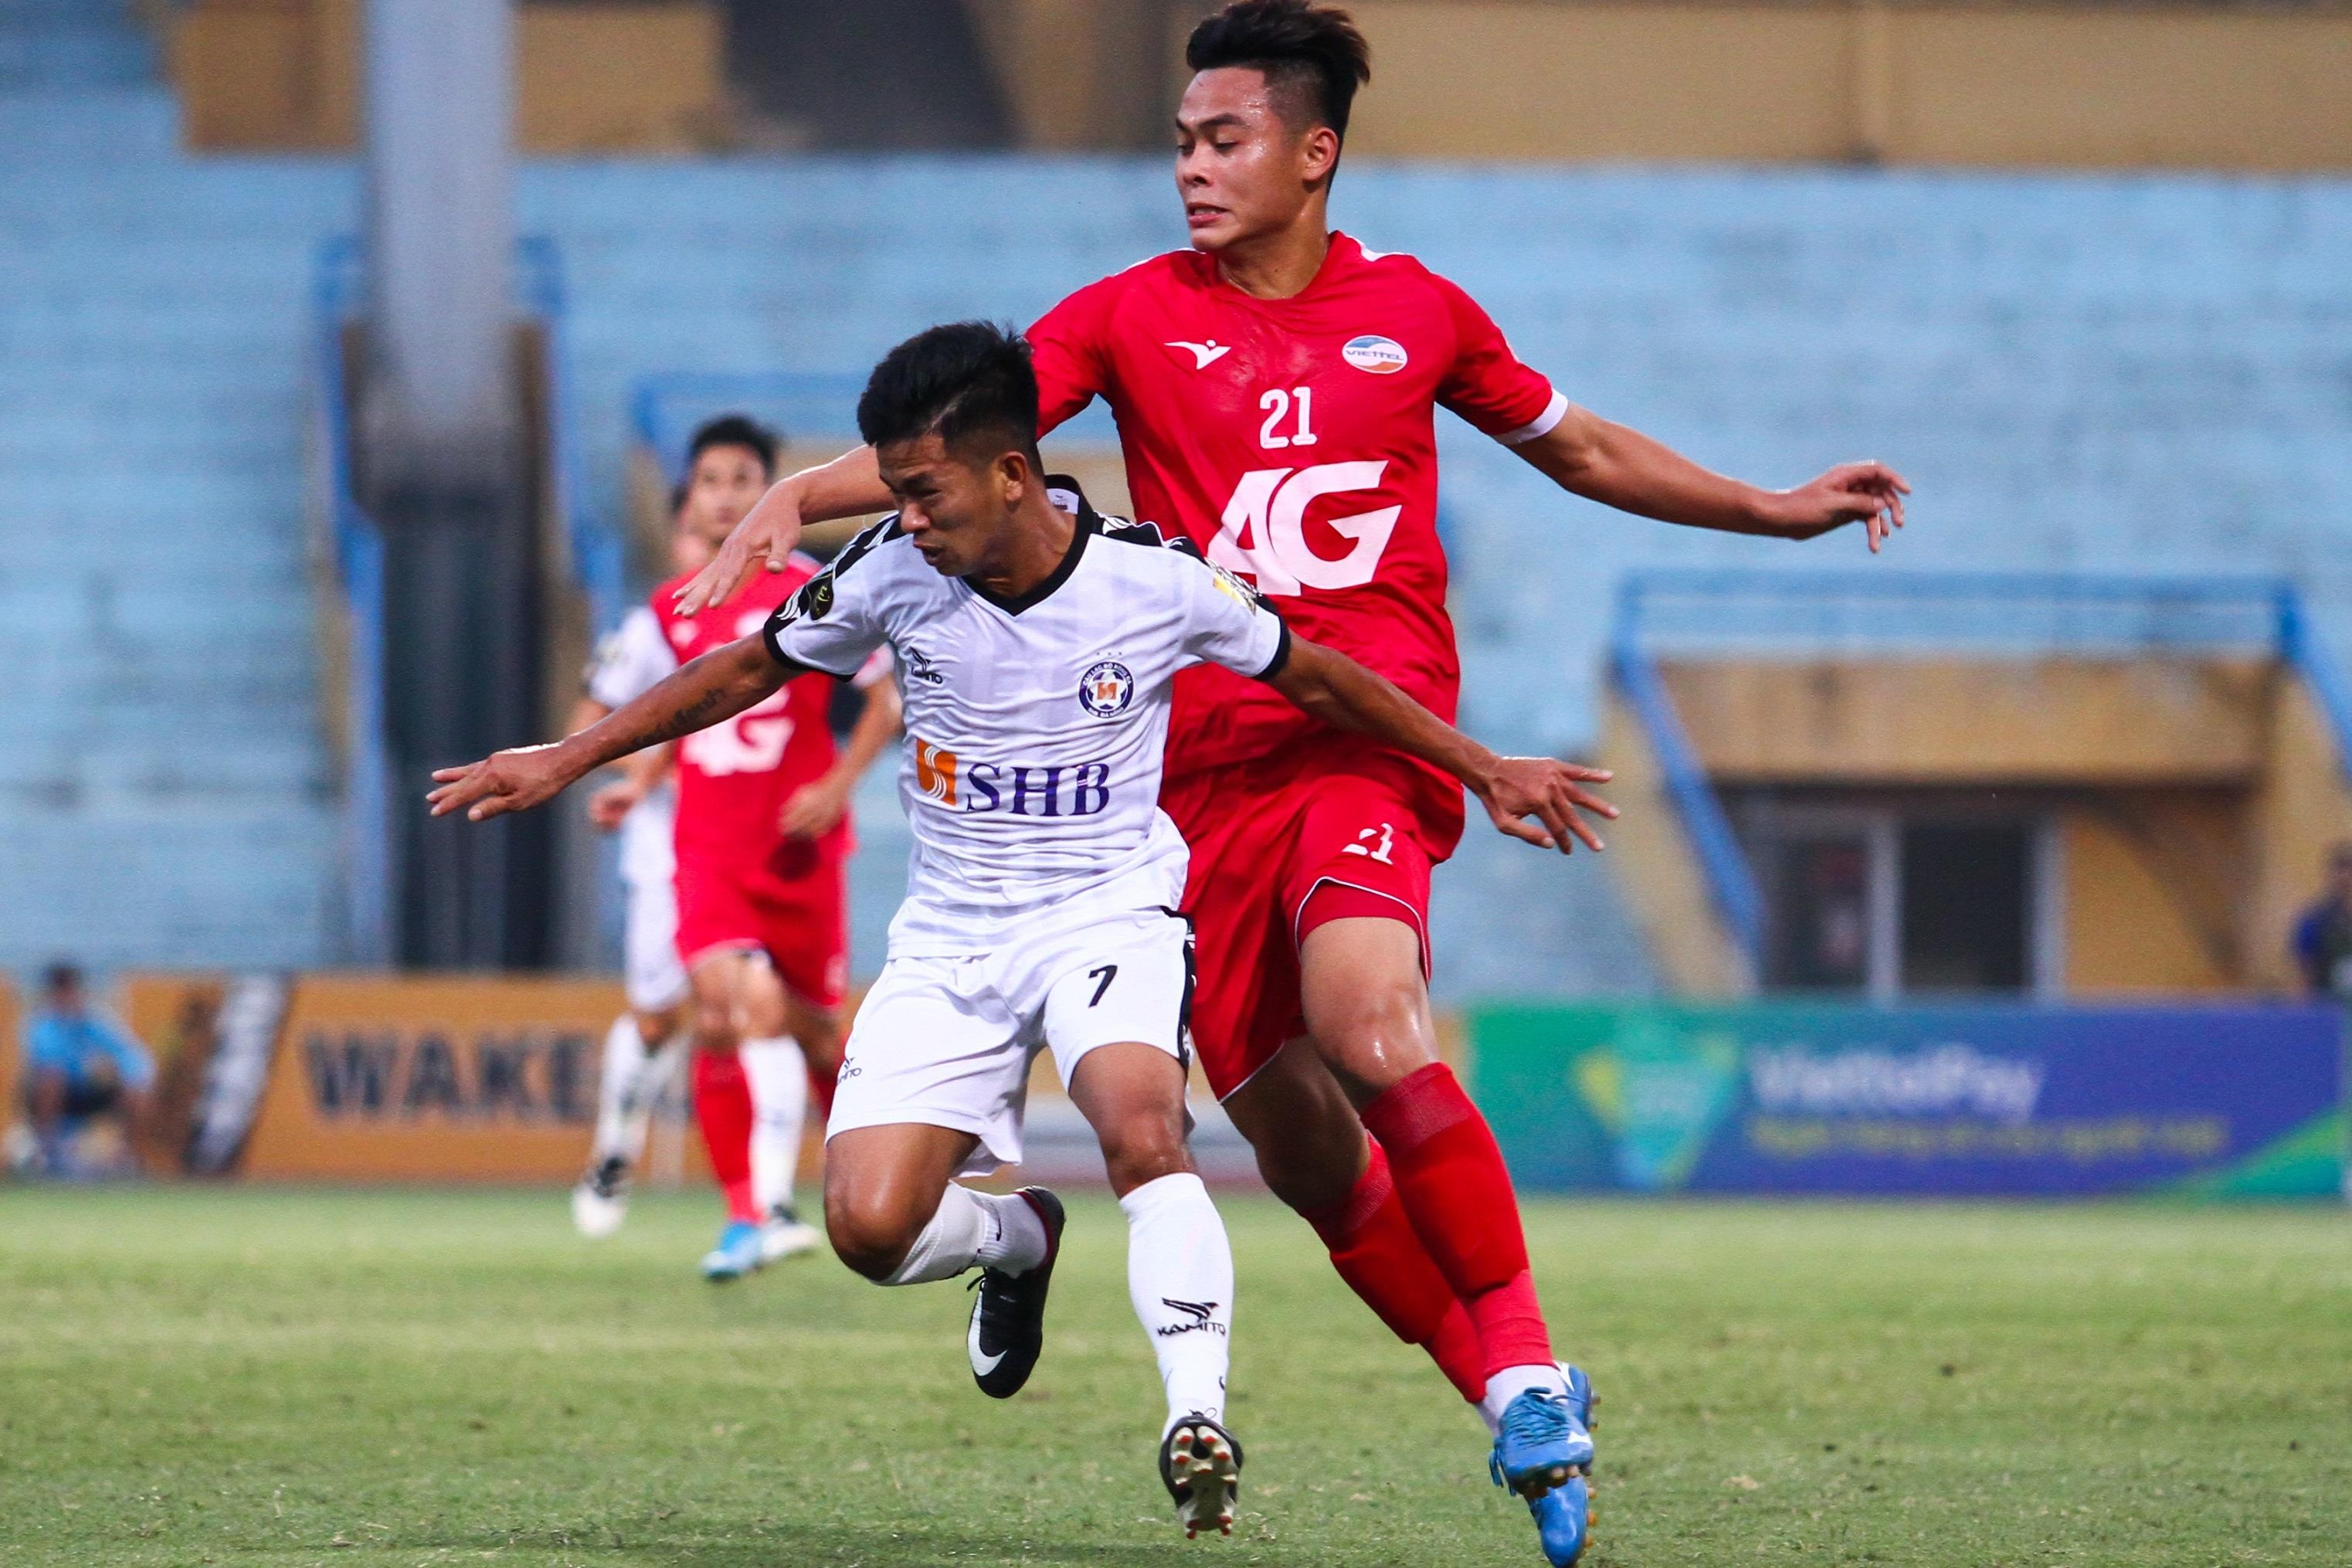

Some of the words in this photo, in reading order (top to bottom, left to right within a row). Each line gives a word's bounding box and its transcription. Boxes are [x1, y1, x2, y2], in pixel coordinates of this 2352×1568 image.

[1346, 349, 1404, 361] VIETTEL
[1259, 386, 1318, 450] 21
[1207, 460, 1403, 597] AG
[966, 762, 1111, 817] SHB
[1341, 822, 1394, 866] 21
[1088, 964, 1118, 1008] 7
[1157, 1320, 1227, 1337] KAMITO
